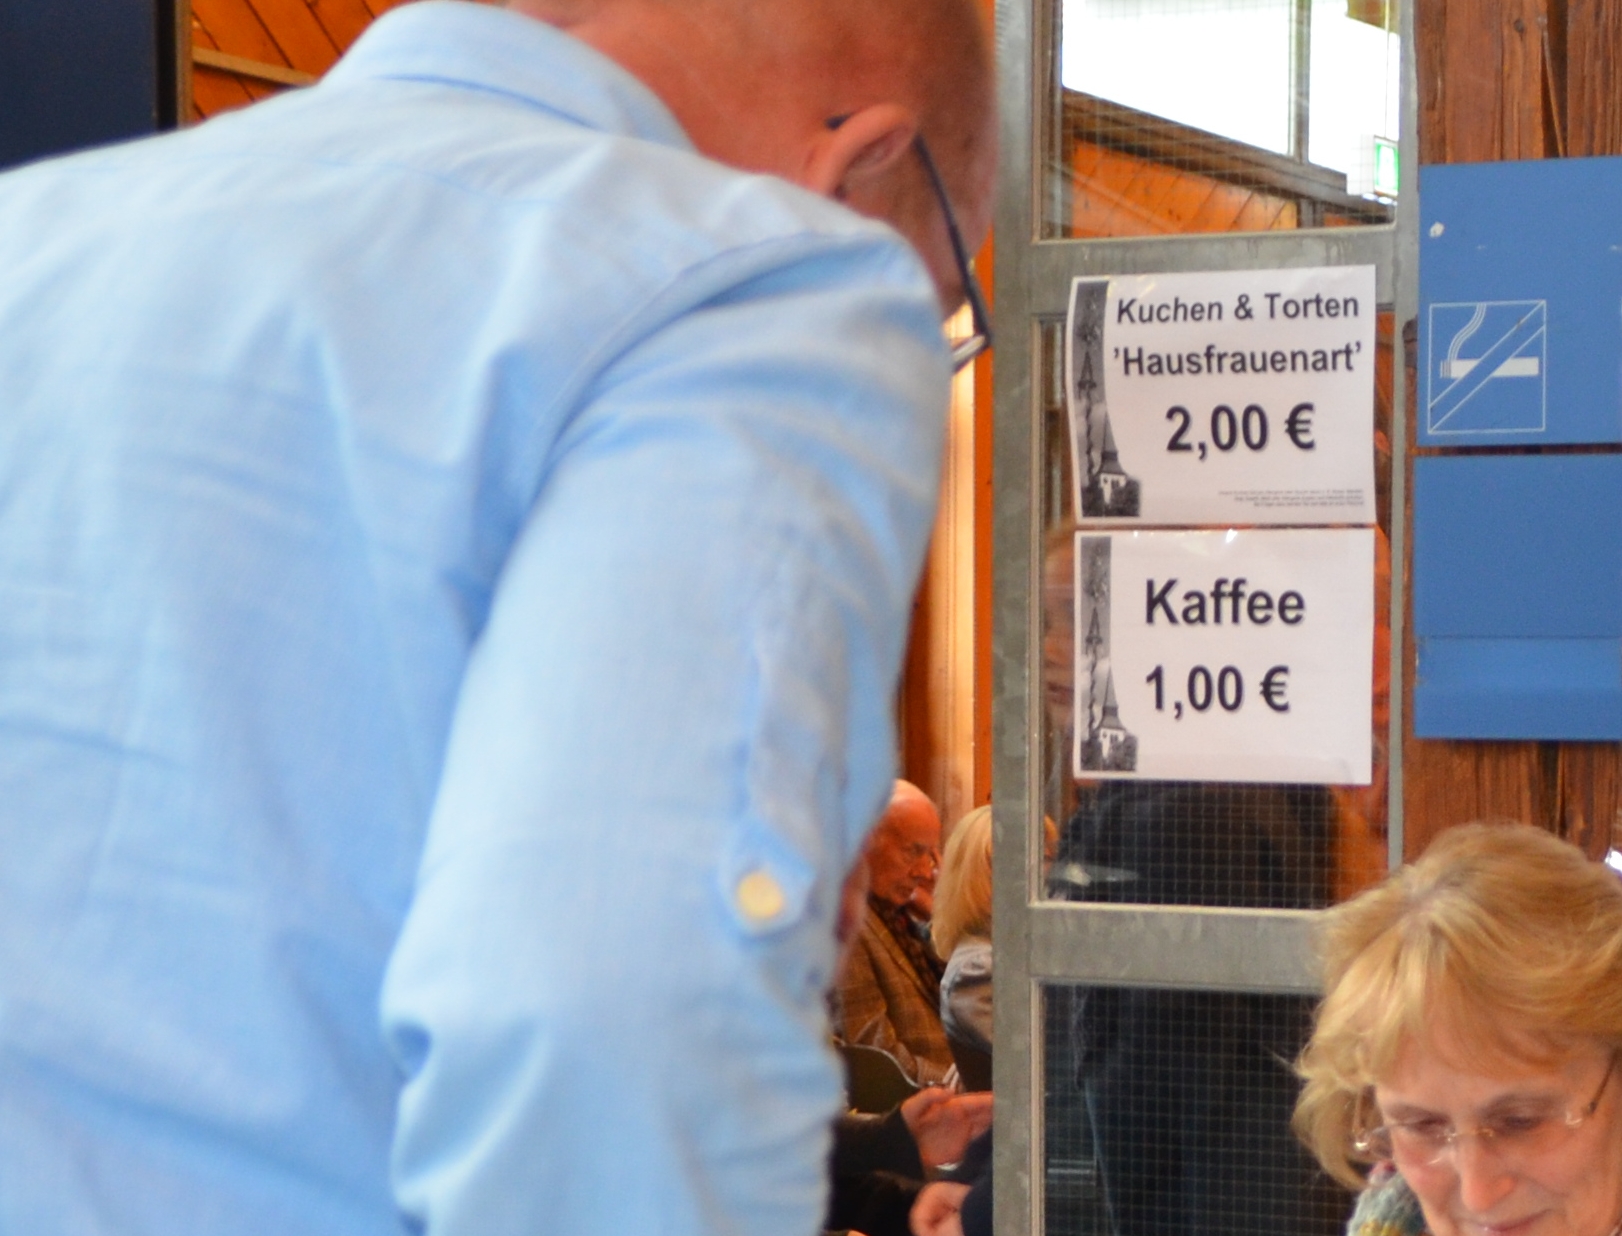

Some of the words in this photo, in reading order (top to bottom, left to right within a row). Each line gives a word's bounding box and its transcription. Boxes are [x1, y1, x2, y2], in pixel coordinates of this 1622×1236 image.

[1118, 297, 1223, 324] Kuchen
[1234, 294, 1253, 320] &
[1264, 293, 1358, 319] Torten
[1166, 404, 1269, 460] 2,00
[1285, 402, 1315, 451] €
[1146, 578, 1305, 626] Kaffee
[1146, 665, 1243, 720] 1,00
[1260, 665, 1290, 713] €
